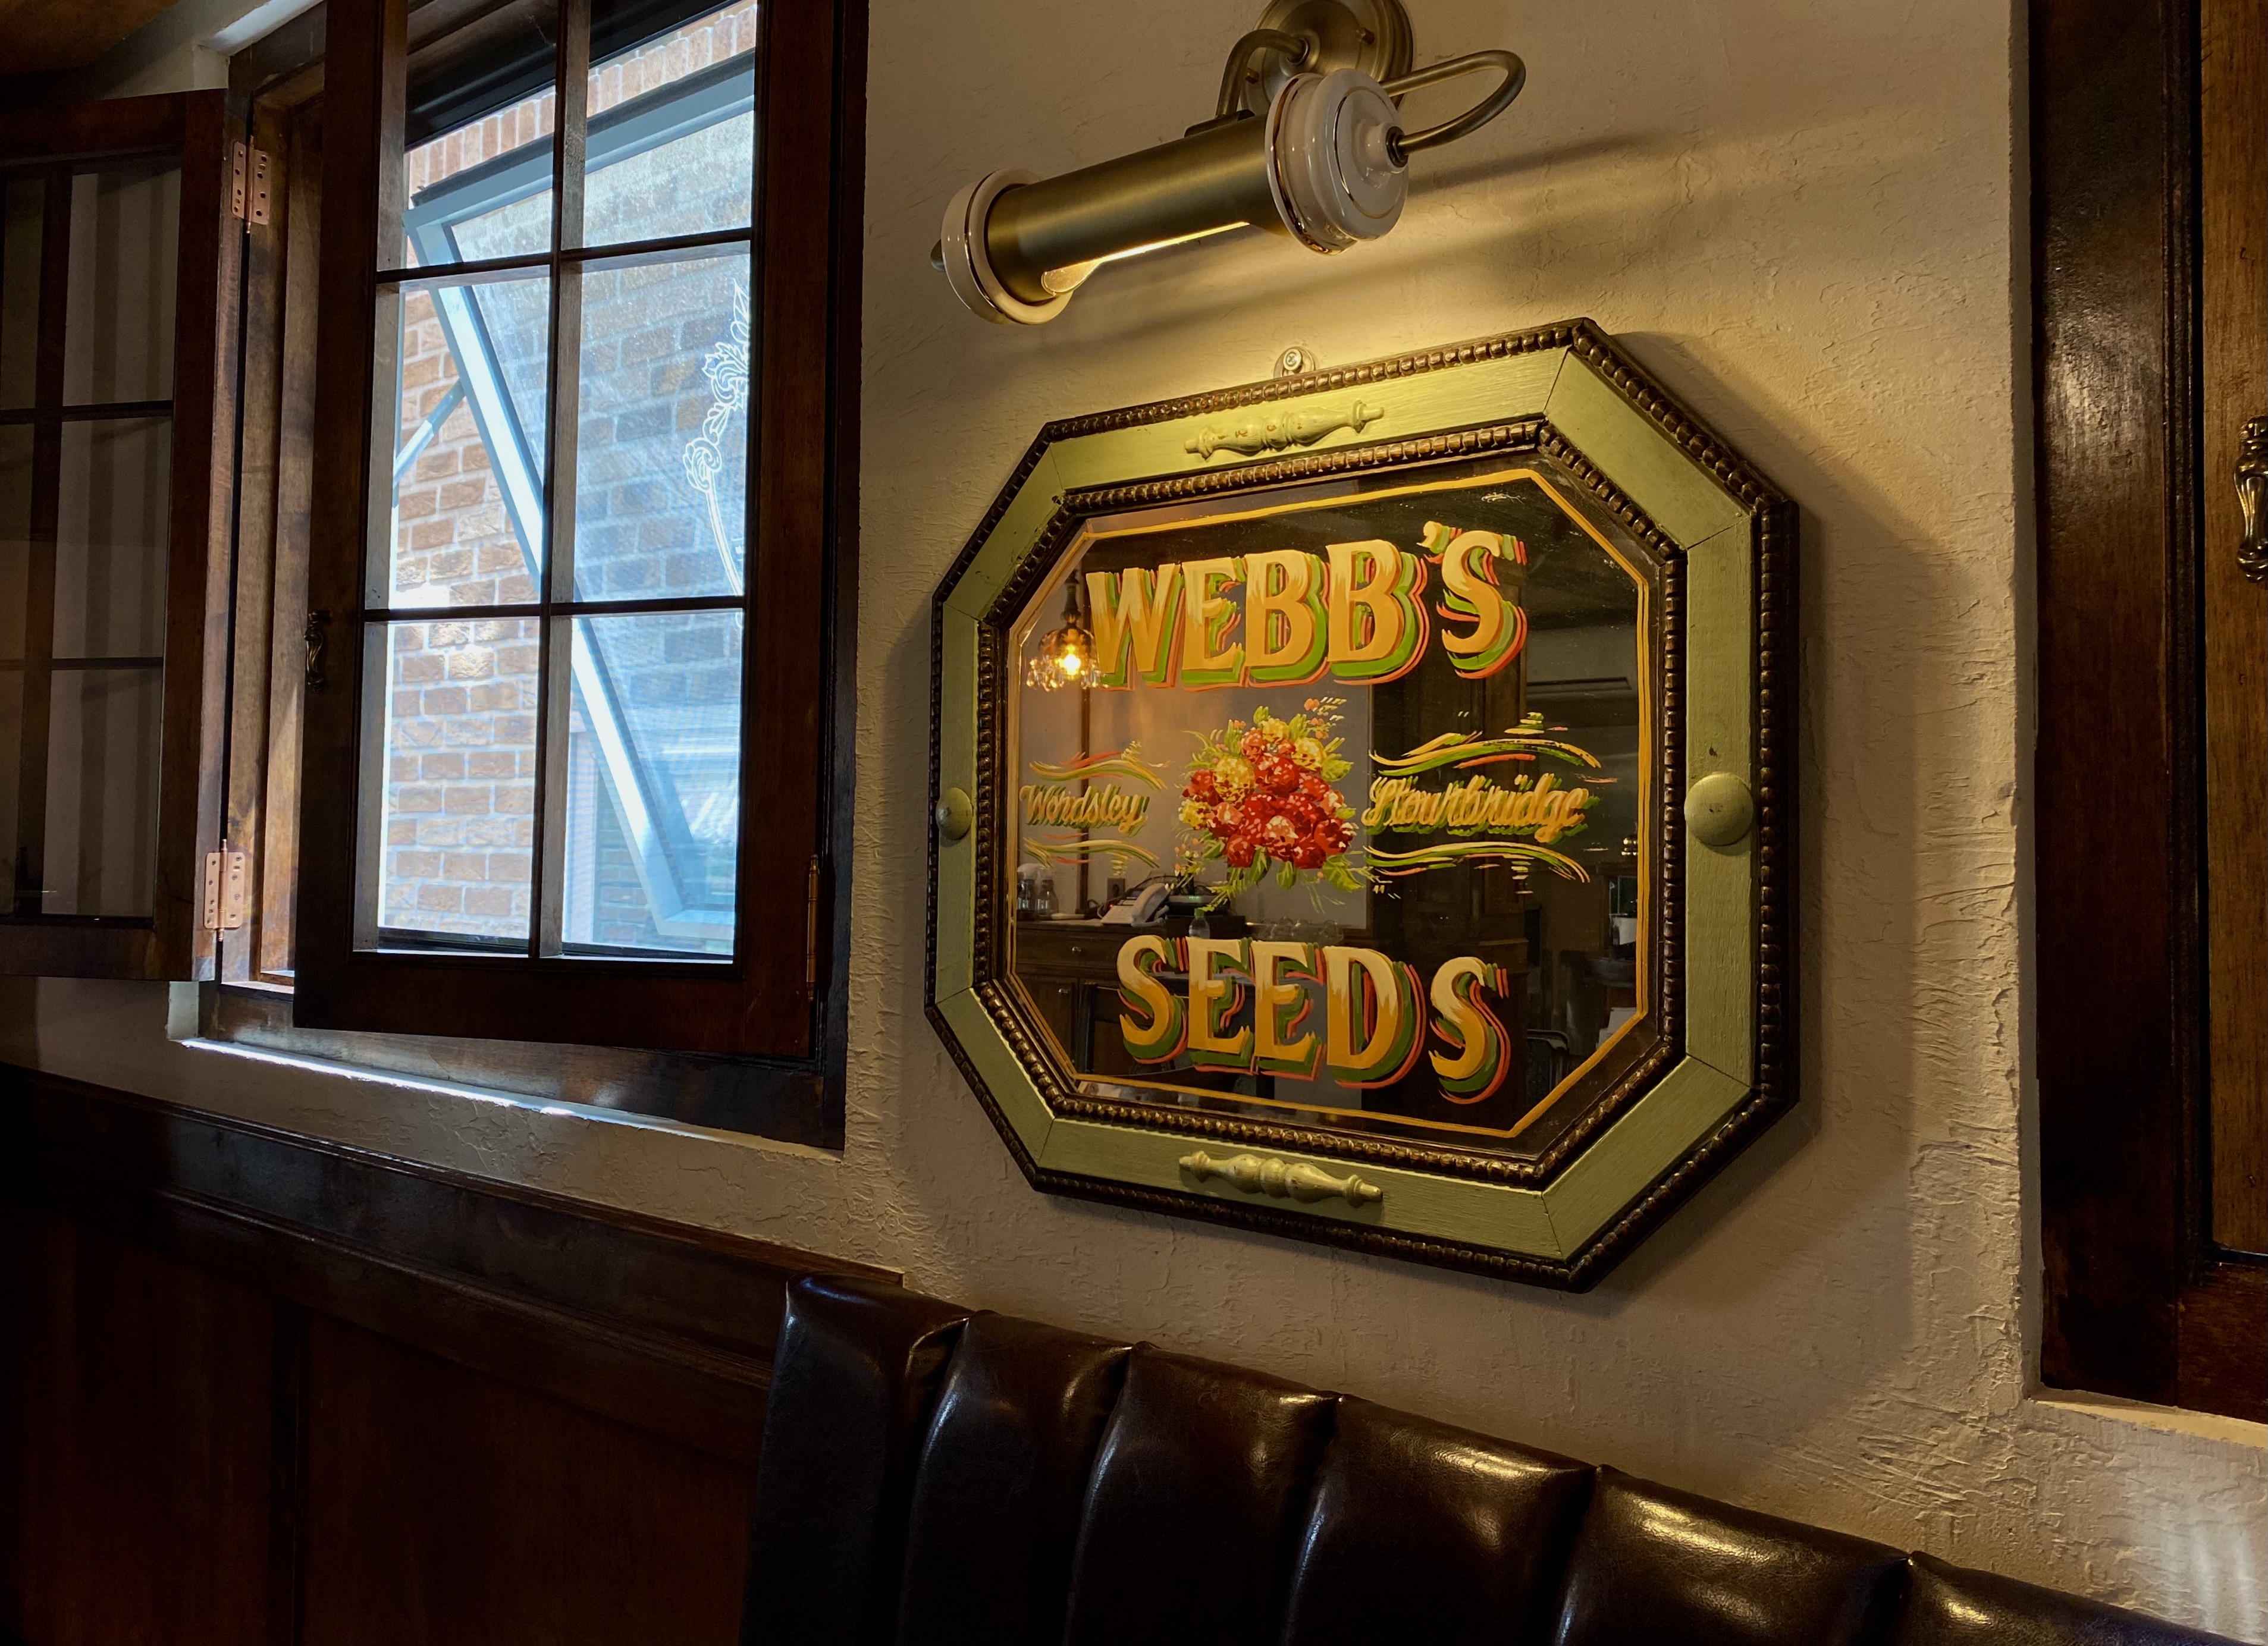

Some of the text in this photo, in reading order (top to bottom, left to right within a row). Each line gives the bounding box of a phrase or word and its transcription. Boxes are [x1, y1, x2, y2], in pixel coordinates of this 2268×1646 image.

[1086, 520, 1527, 690] WEBB'S
[1019, 783, 1150, 837] Wordsley
[1361, 772, 1600, 845] Stourbridge
[1116, 935, 1510, 1104] SEEDS
